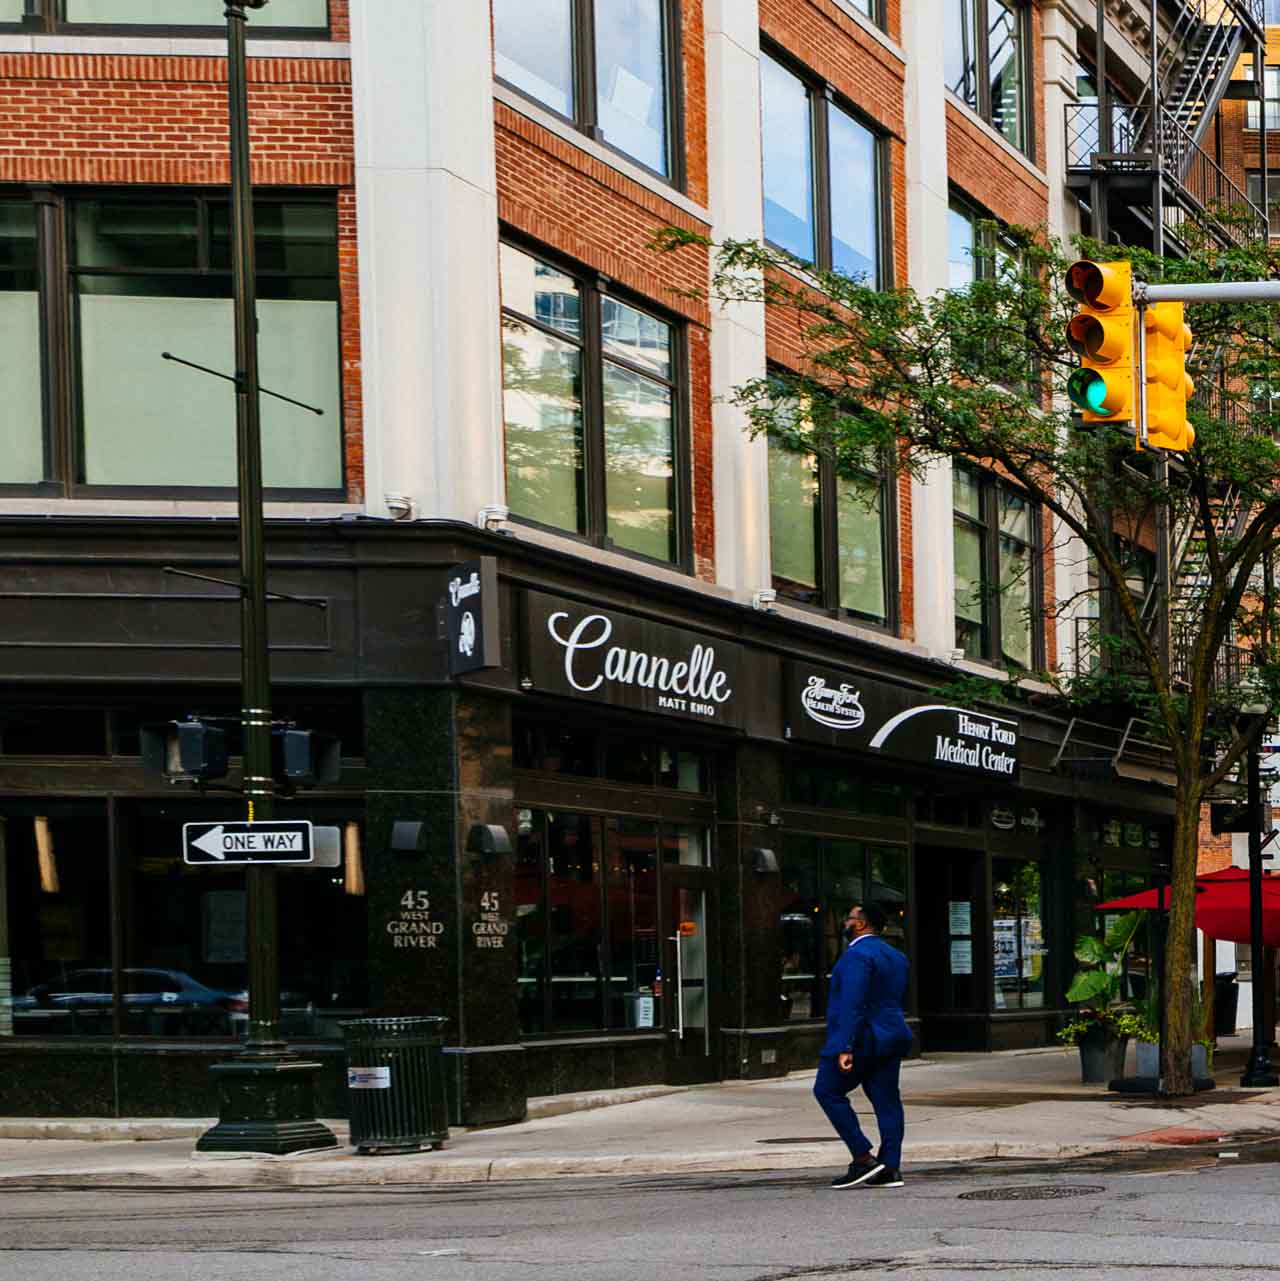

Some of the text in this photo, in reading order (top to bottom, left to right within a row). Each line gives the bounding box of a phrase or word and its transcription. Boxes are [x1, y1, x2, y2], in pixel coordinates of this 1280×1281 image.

[547, 612, 732, 703] Cannelle
[839, 683, 860, 704] Ford
[658, 695, 687, 712] MATT
[935, 735, 1016, 775] Medical Center
[223, 834, 297, 850] ONE WAY
[400, 890, 430, 910] 45
[480, 892, 499, 911] 45
[400, 911, 430, 921] WEST
[386, 921, 444, 934] GRAND
[472, 922, 508, 935] GRAND
[393, 935, 437, 948] RIVER
[476, 936, 504, 948] RIVER
